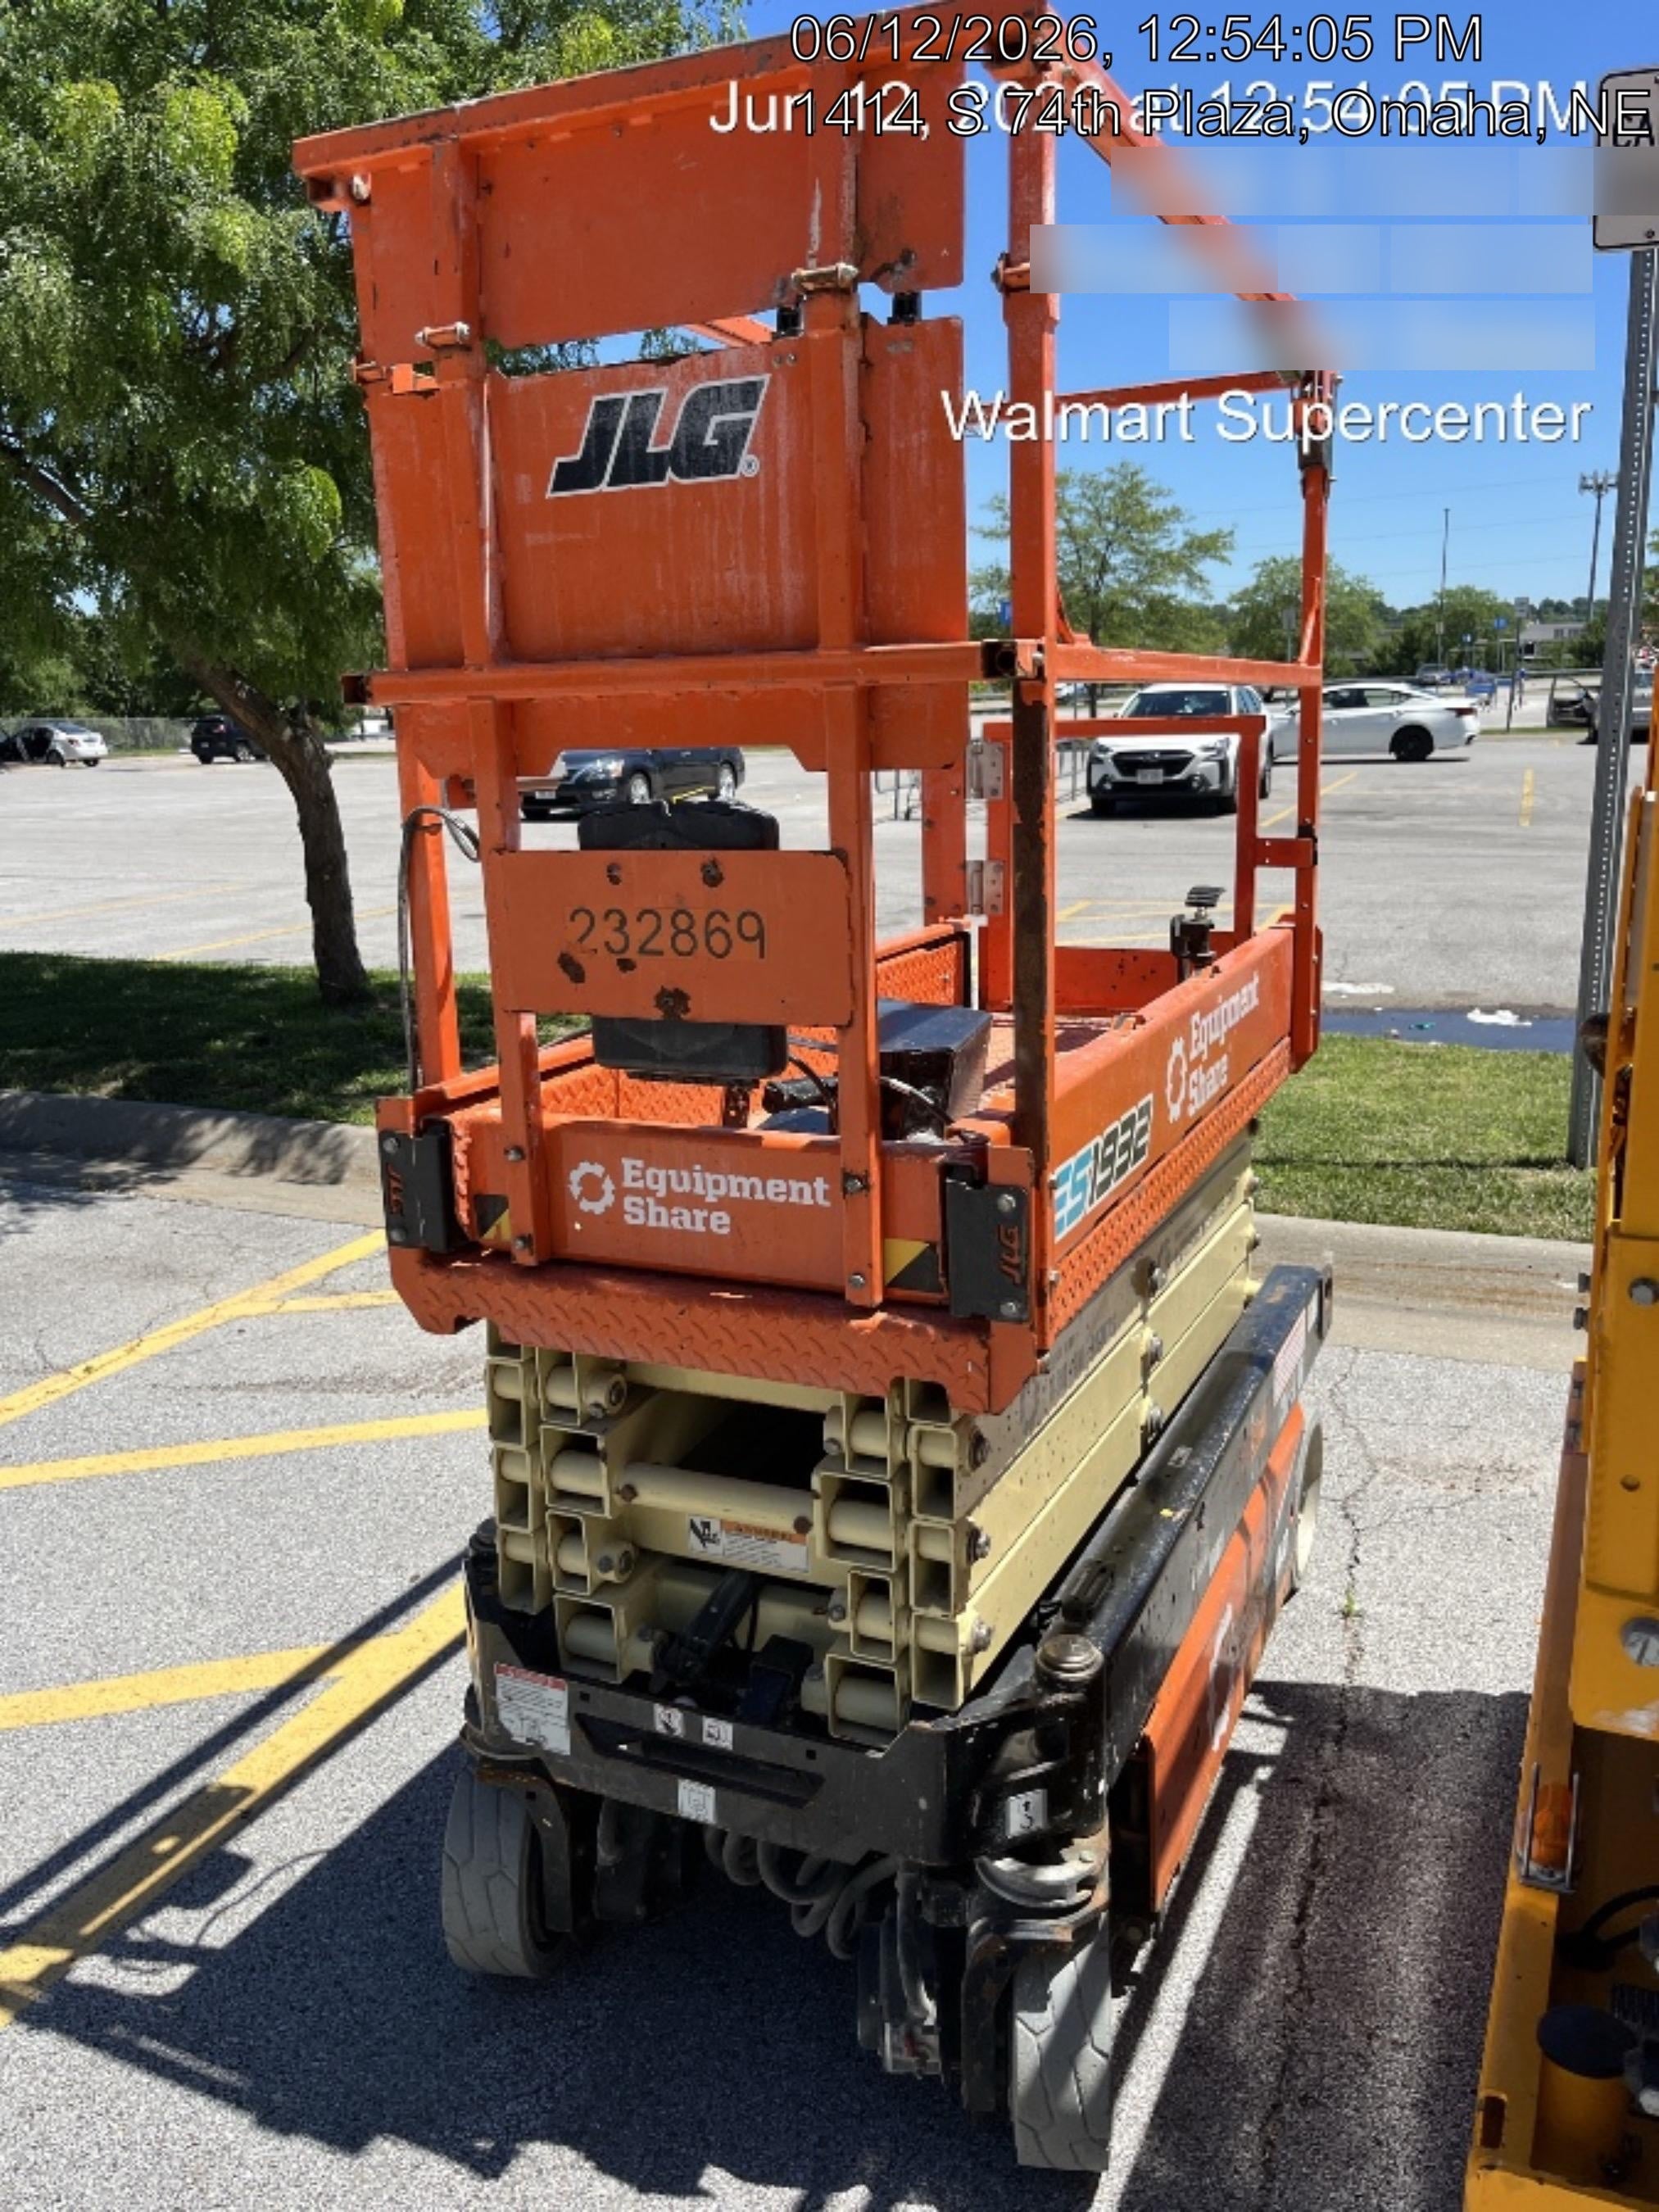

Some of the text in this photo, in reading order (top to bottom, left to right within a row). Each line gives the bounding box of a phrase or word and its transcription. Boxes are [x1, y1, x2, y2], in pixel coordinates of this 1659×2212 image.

[569, 907, 766, 959] 232869
[1189, 971, 1259, 1062] Equipment
[1187, 1054, 1228, 1117] Share
[620, 1157, 832, 1207] Equipment
[623, 1194, 732, 1235] Share
